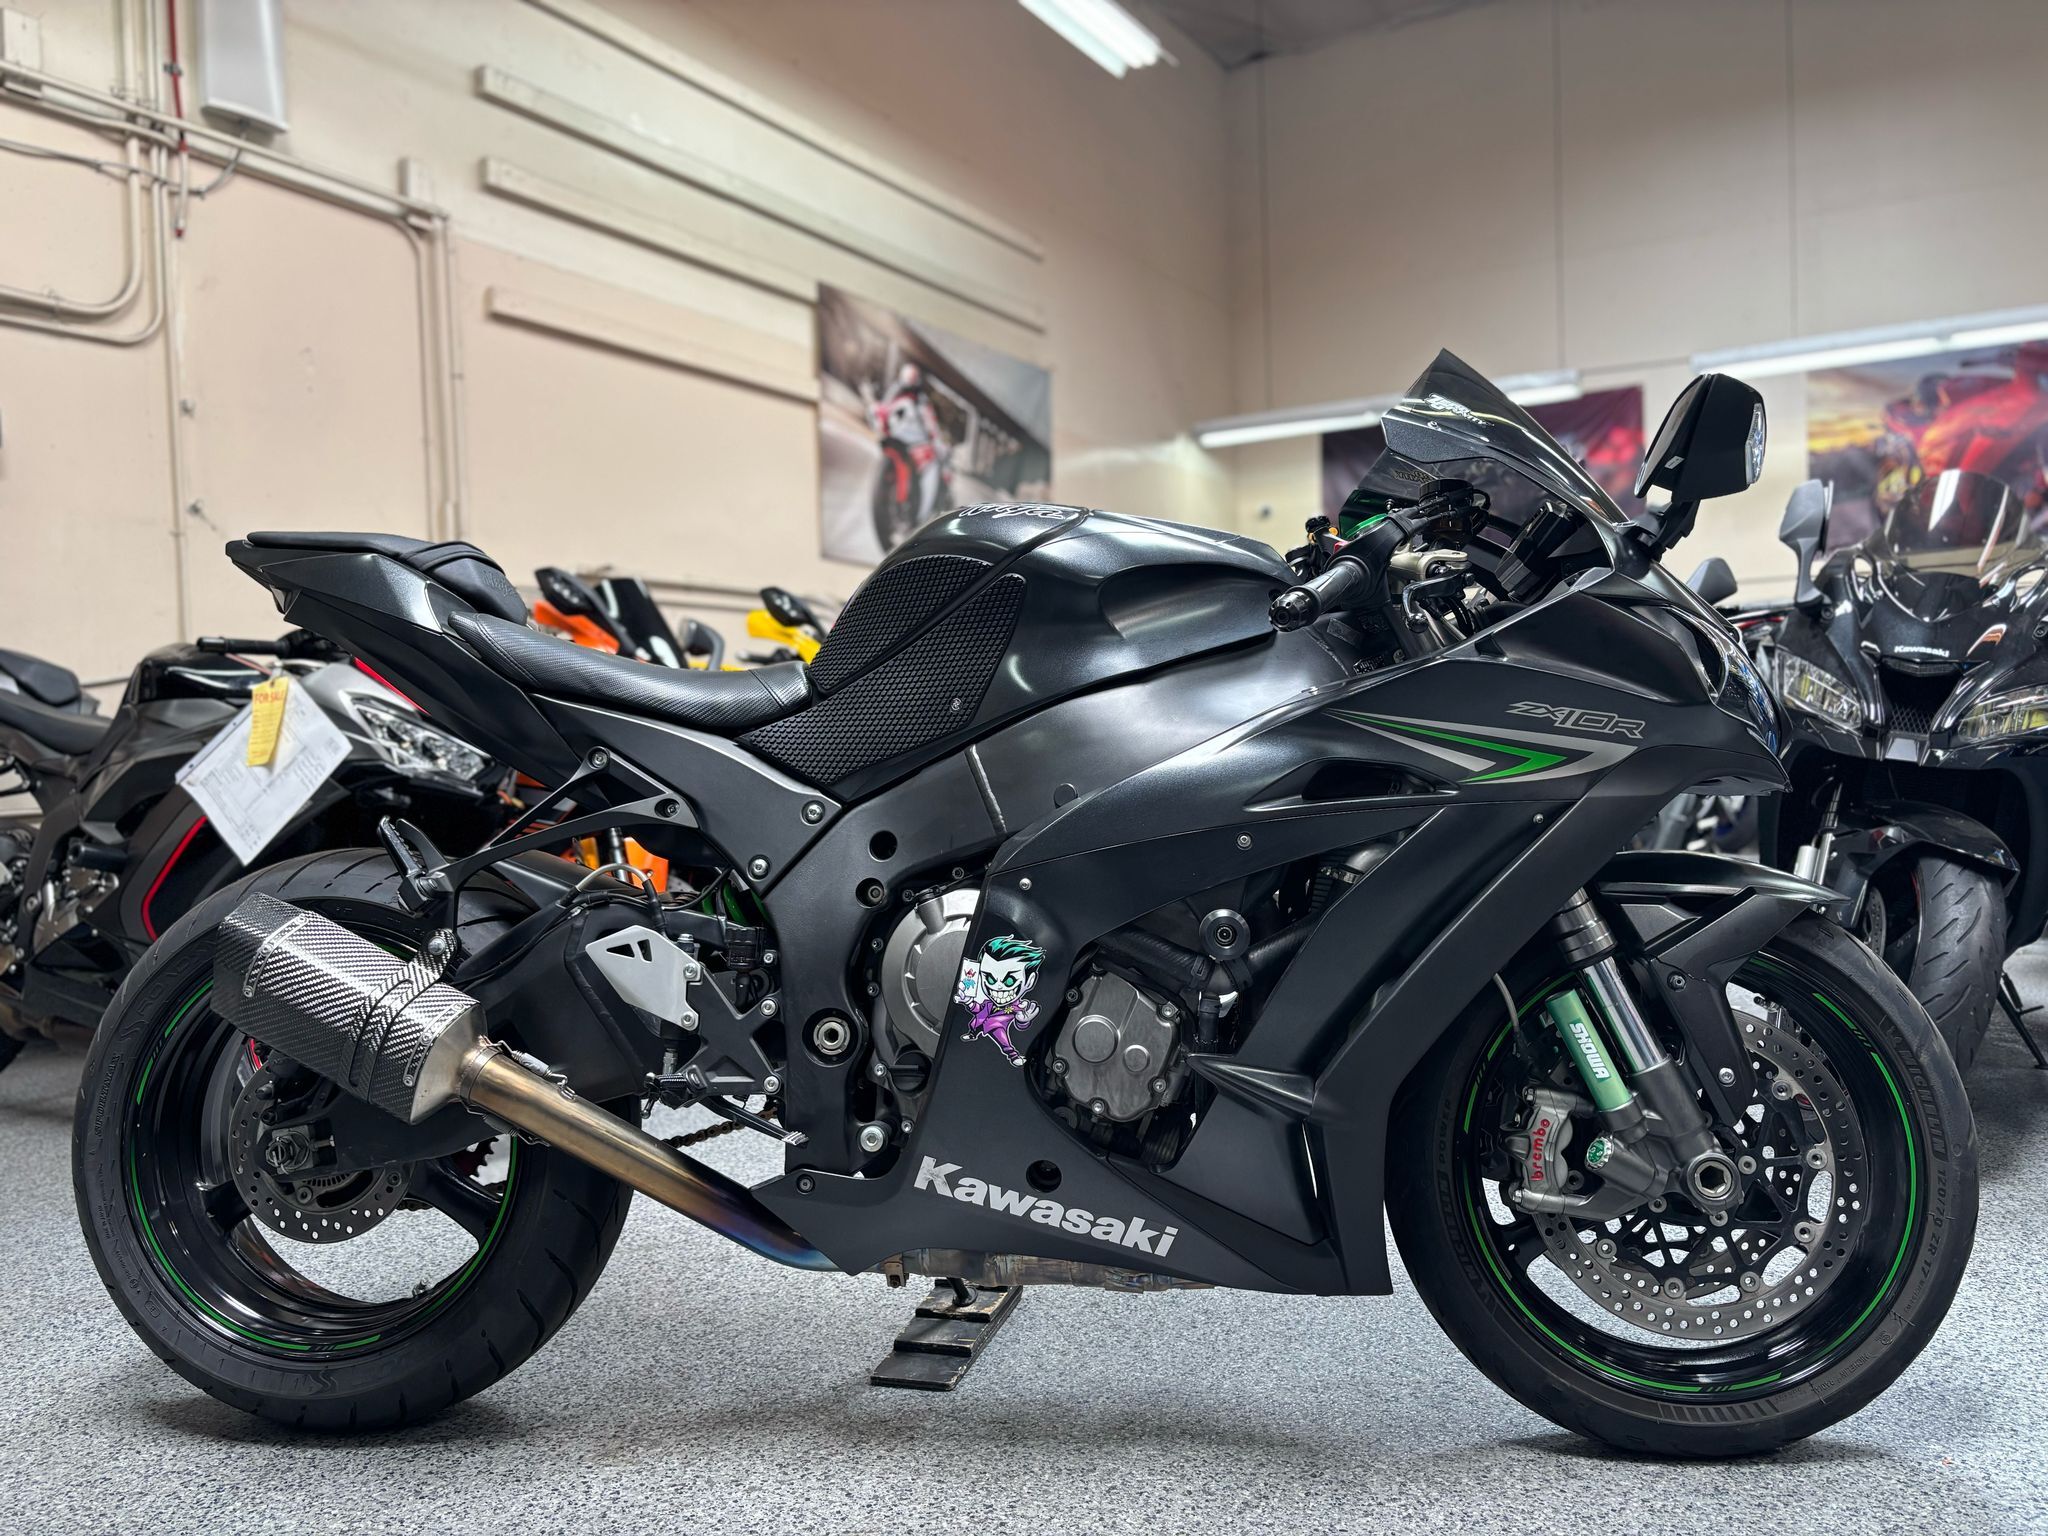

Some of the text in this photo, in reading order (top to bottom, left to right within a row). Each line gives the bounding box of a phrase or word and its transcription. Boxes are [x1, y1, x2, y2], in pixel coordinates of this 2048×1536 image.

[1893, 645, 1950, 658] Kawasaki
[254, 692, 269, 705] FOR
[1569, 1022, 1610, 1079] SHOWA
[1531, 1118, 1551, 1181] brembo
[914, 1155, 1179, 1257] Kawasaki
